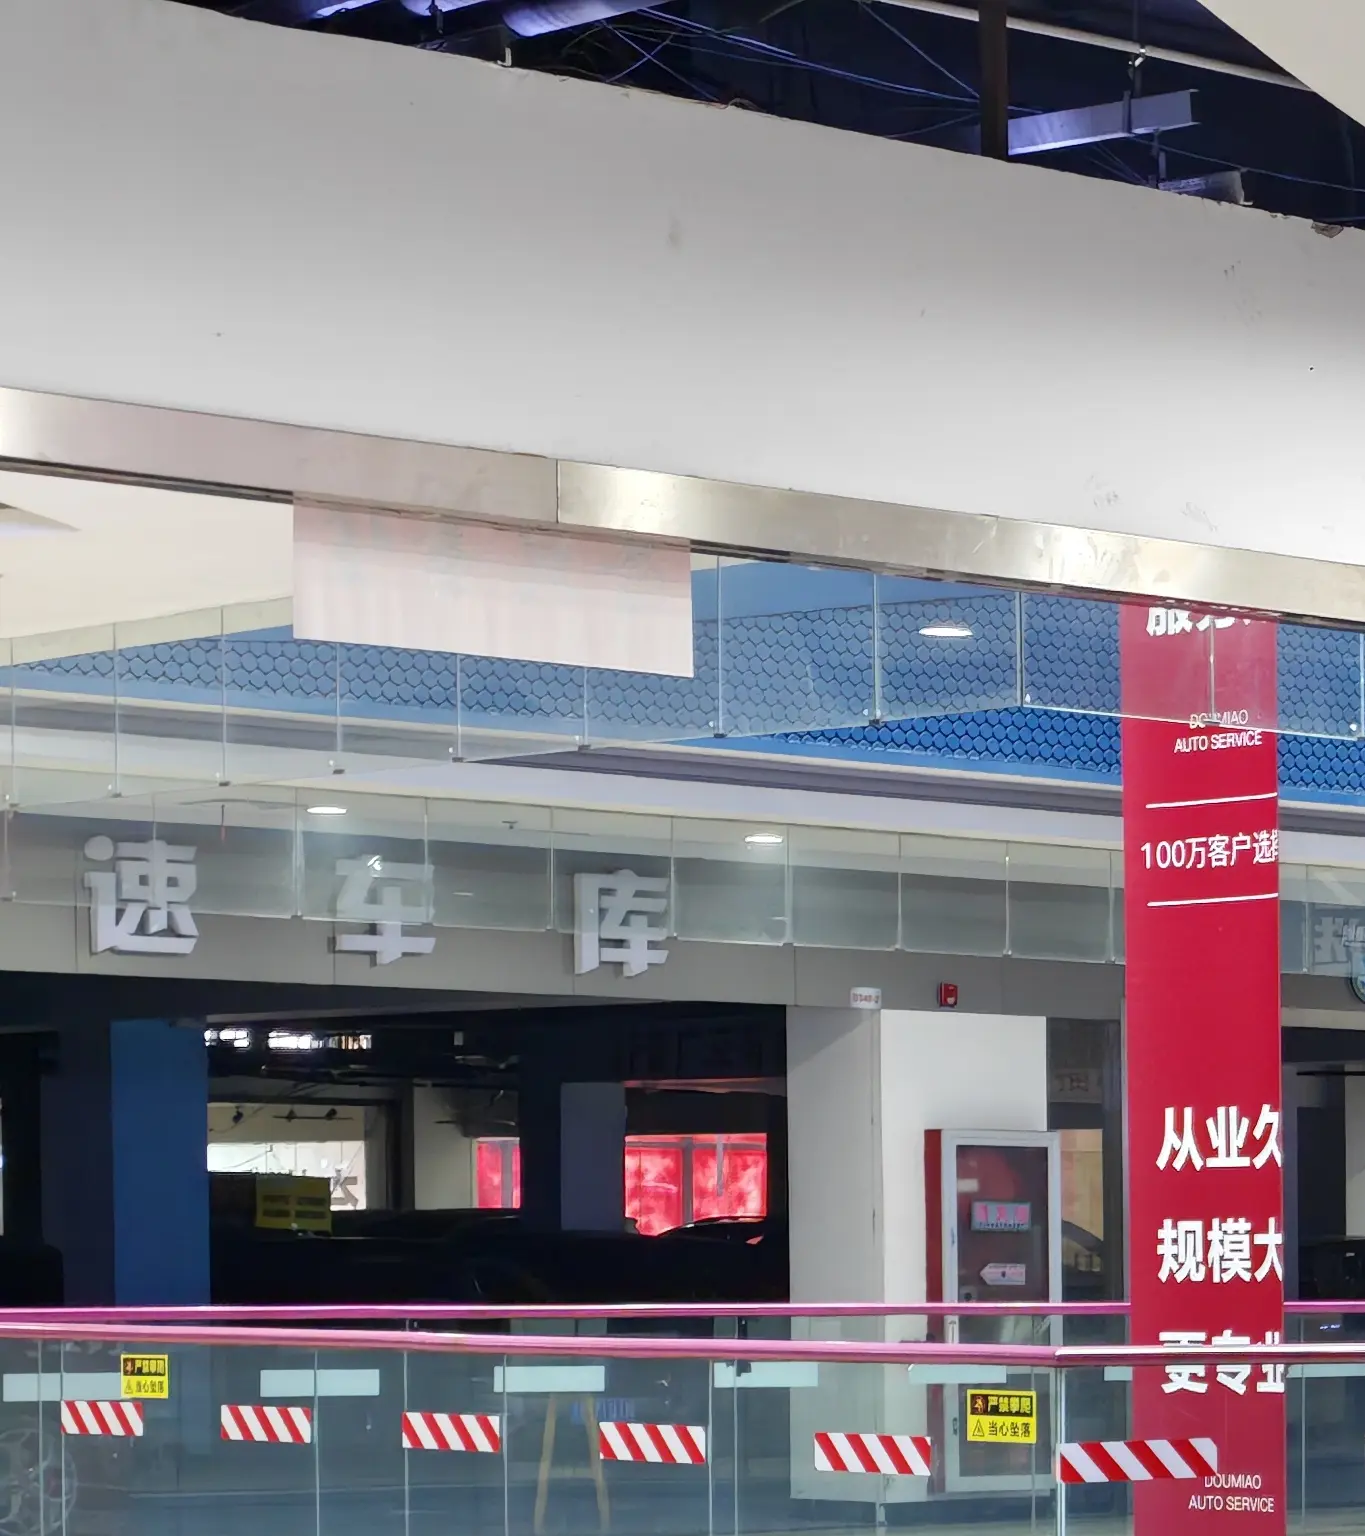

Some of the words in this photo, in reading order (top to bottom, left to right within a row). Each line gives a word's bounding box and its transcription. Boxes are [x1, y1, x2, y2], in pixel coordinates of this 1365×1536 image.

[1189, 709, 1249, 729] DOMIAO
[1174, 736, 1208, 753] AUTO
[1211, 730, 1262, 750] SERVICE
[1156, 1103, 1282, 1172] 从业久
[1157, 1217, 1283, 1284] 规模大
[1205, 1473, 1262, 1489] DOUMIAO
[1188, 1495, 1224, 1511] AUTO
[1225, 1497, 1275, 1513] SERVICE
